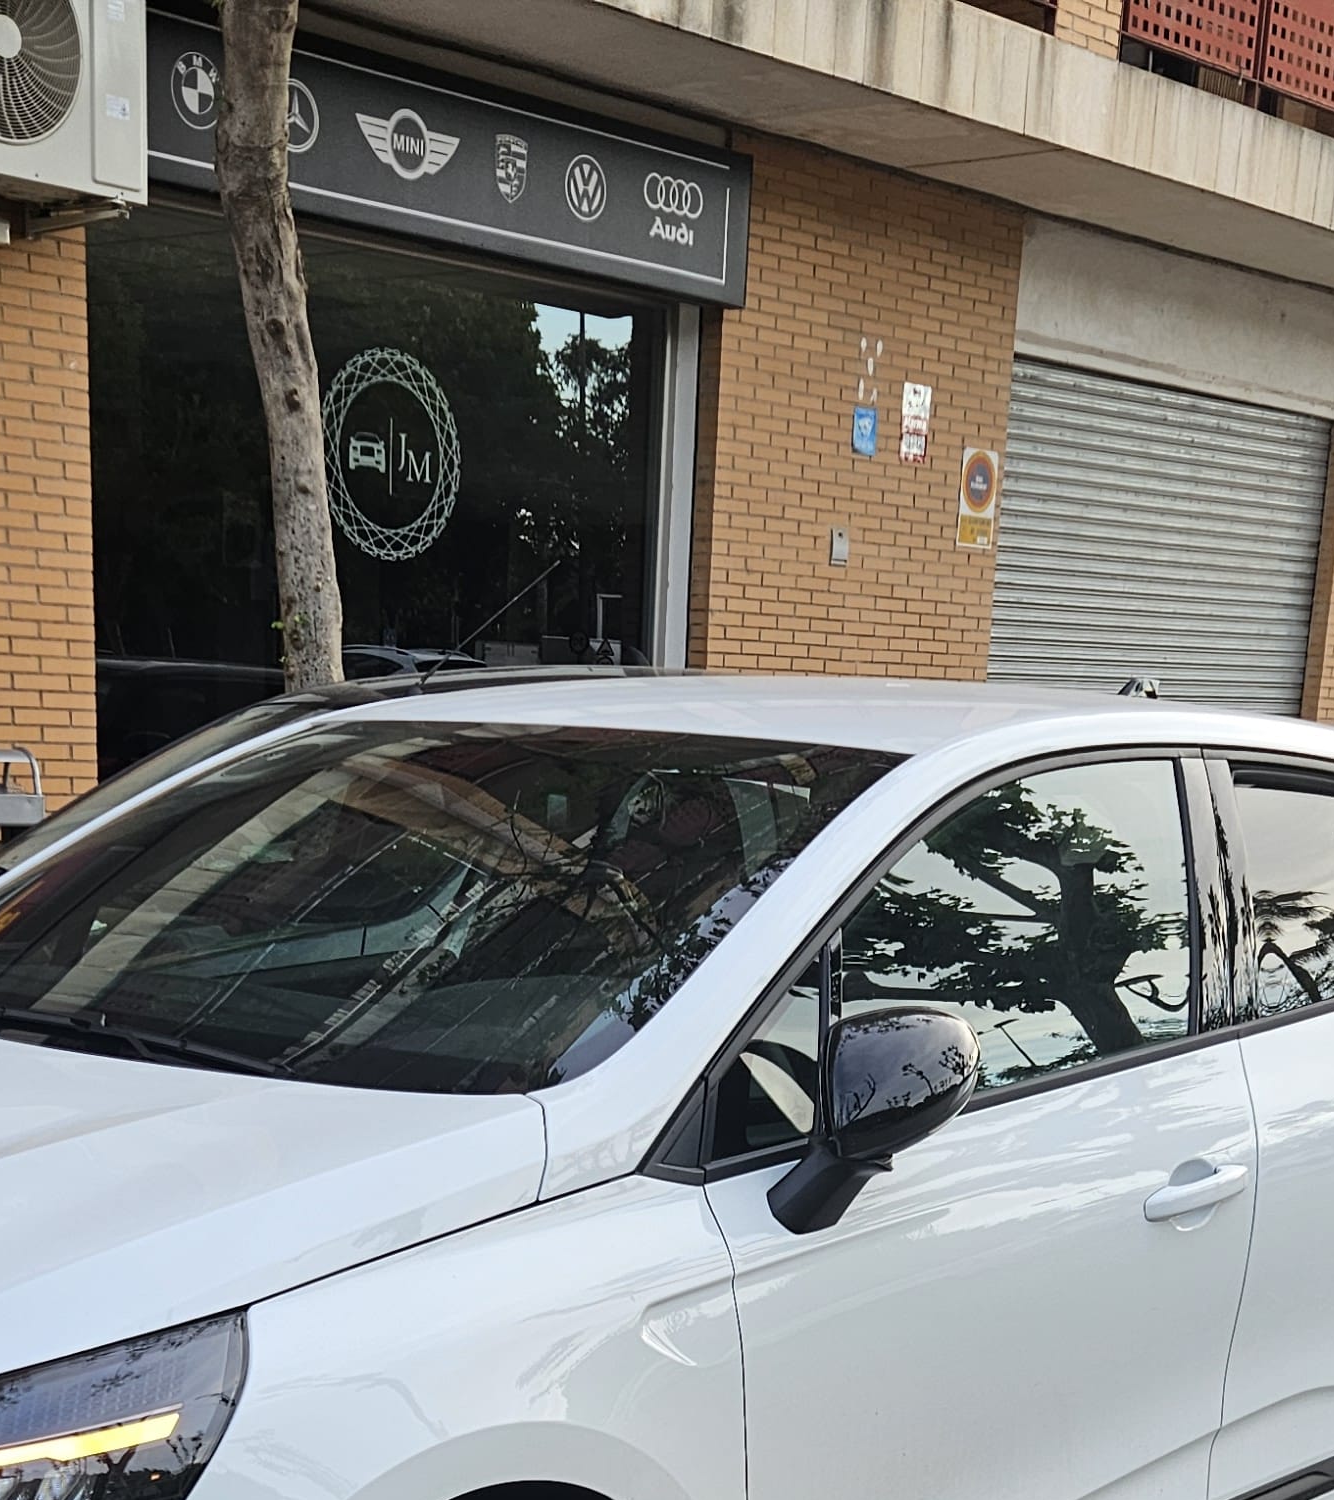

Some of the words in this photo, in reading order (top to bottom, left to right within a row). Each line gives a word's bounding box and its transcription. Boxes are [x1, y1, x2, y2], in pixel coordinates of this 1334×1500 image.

[392, 132, 425, 158] MINI
[648, 215, 695, 247] Audi
[398, 432, 433, 484] JM
